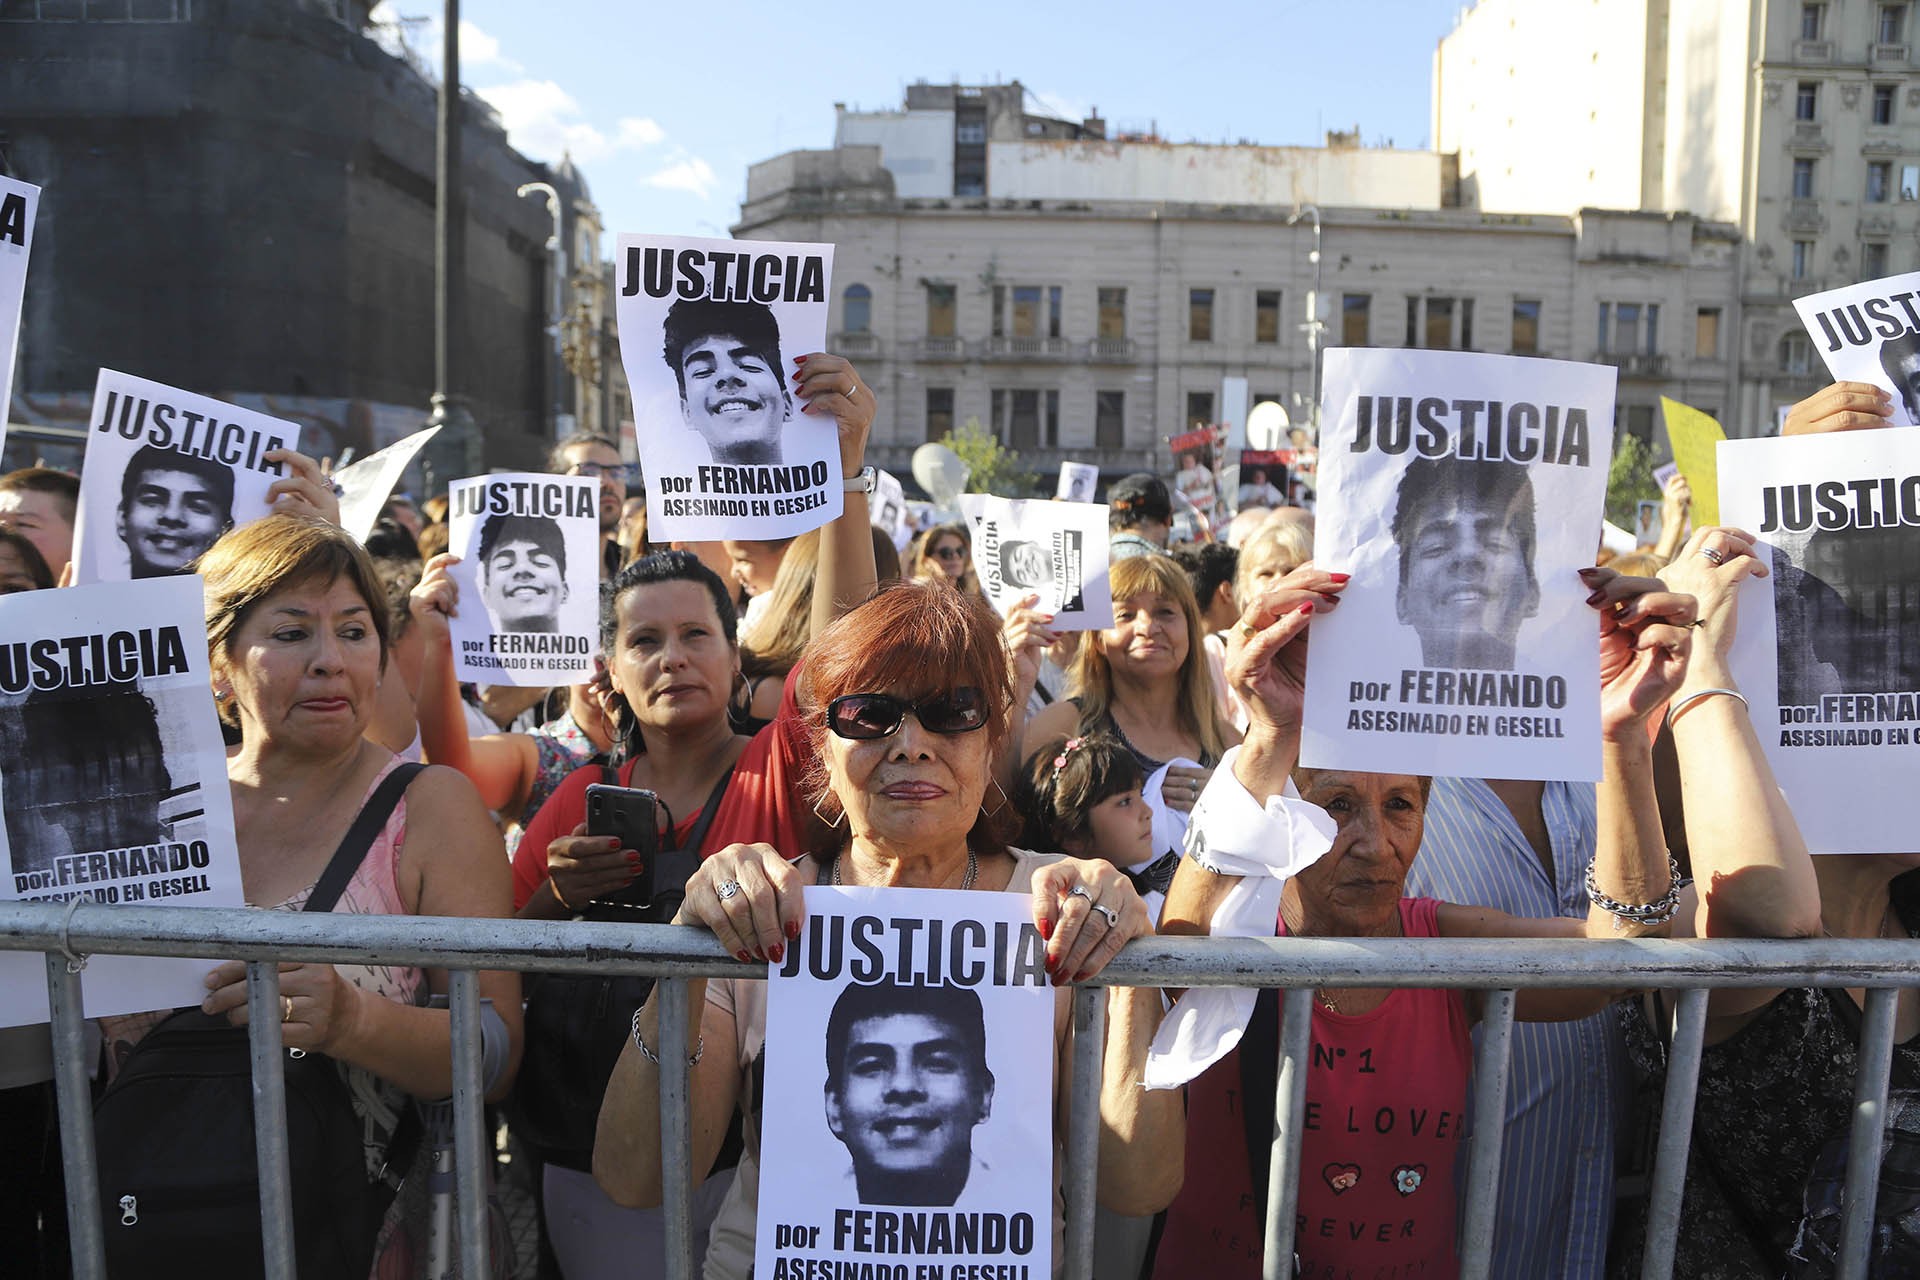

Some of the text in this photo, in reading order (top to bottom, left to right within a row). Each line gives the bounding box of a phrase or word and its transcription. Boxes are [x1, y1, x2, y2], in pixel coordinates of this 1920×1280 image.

[622, 247, 825, 302] JUSTICIA
[1815, 291, 1920, 352] JUST
[99, 391, 284, 476] JUSTICIA
[1350, 395, 1590, 467] JUSTICIA
[660, 460, 828, 495] por FERNANDO
[455, 482, 595, 518] JUSTICIA
[664, 491, 828, 516] ASESINADO EN GESELL
[463, 633, 589, 655] por FERNANDO
[464, 654, 588, 670] ASESINADO EN GESELL
[1349, 669, 1567, 710] por FERNANDO
[1347, 709, 1565, 738] ASESINADO EN GESELL
[1780, 694, 1920, 725] por FERNA
[1780, 728, 1883, 747] ASESINADO
[1887, 727, 1909, 745] EN
[15, 840, 210, 894] por FERNANDO
[123, 883, 144, 902] EN
[148, 874, 211, 899] GESELL
[780, 914, 1047, 987] JUSTICIA
[776, 1208, 1034, 1255] por FERNANDO
[1240, 1192, 1415, 1242] FREVER
